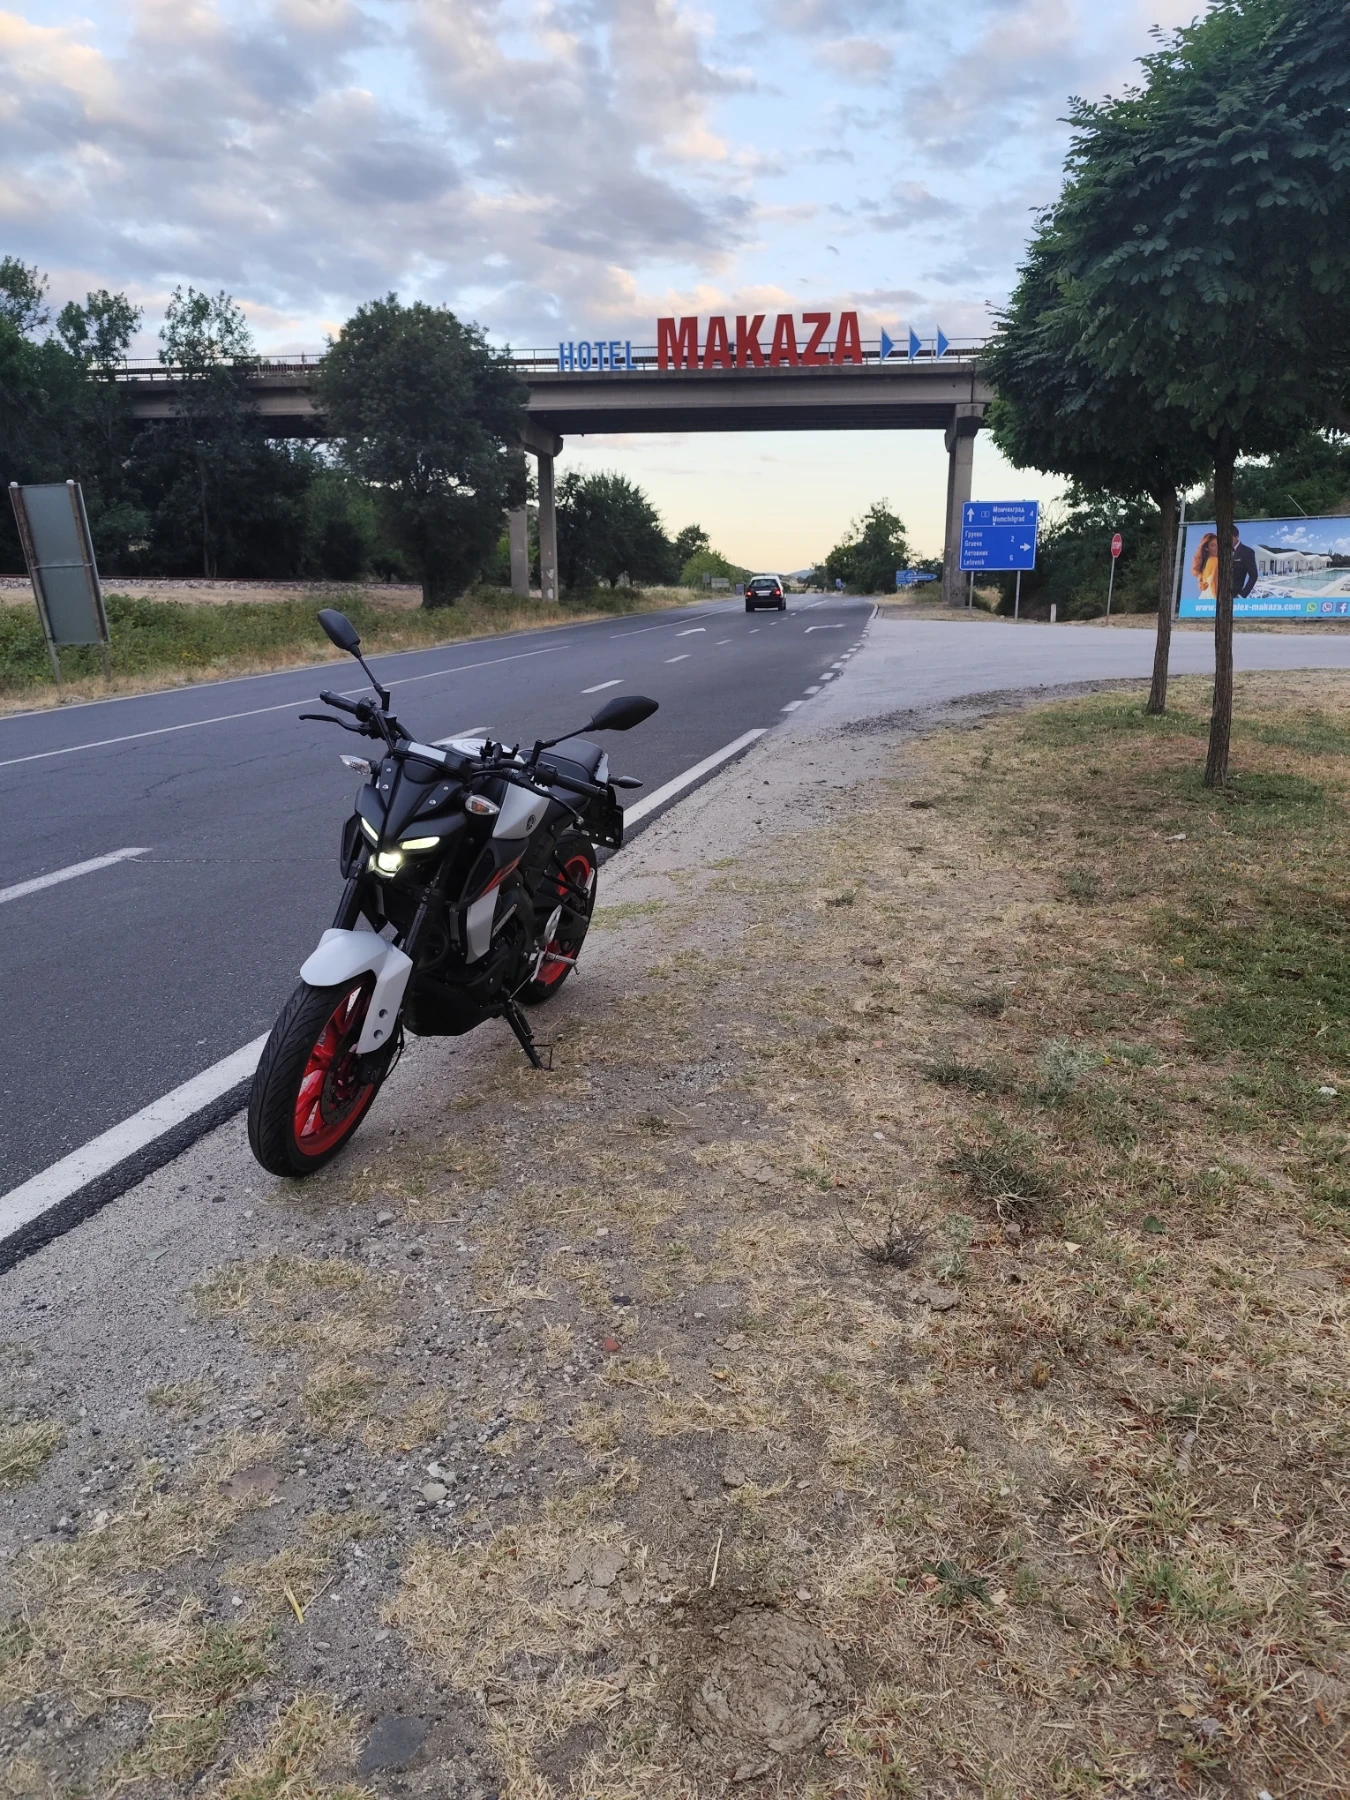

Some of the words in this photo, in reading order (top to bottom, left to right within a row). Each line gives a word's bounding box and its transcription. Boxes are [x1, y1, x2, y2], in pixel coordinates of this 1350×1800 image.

[559, 341, 637, 371] HOTEL
[657, 311, 863, 371] MAKAZA
[992, 515, 1025, 524] Momchilgrad
[1010, 535, 1015, 543] 2
[1009, 554, 1014, 562] 6
